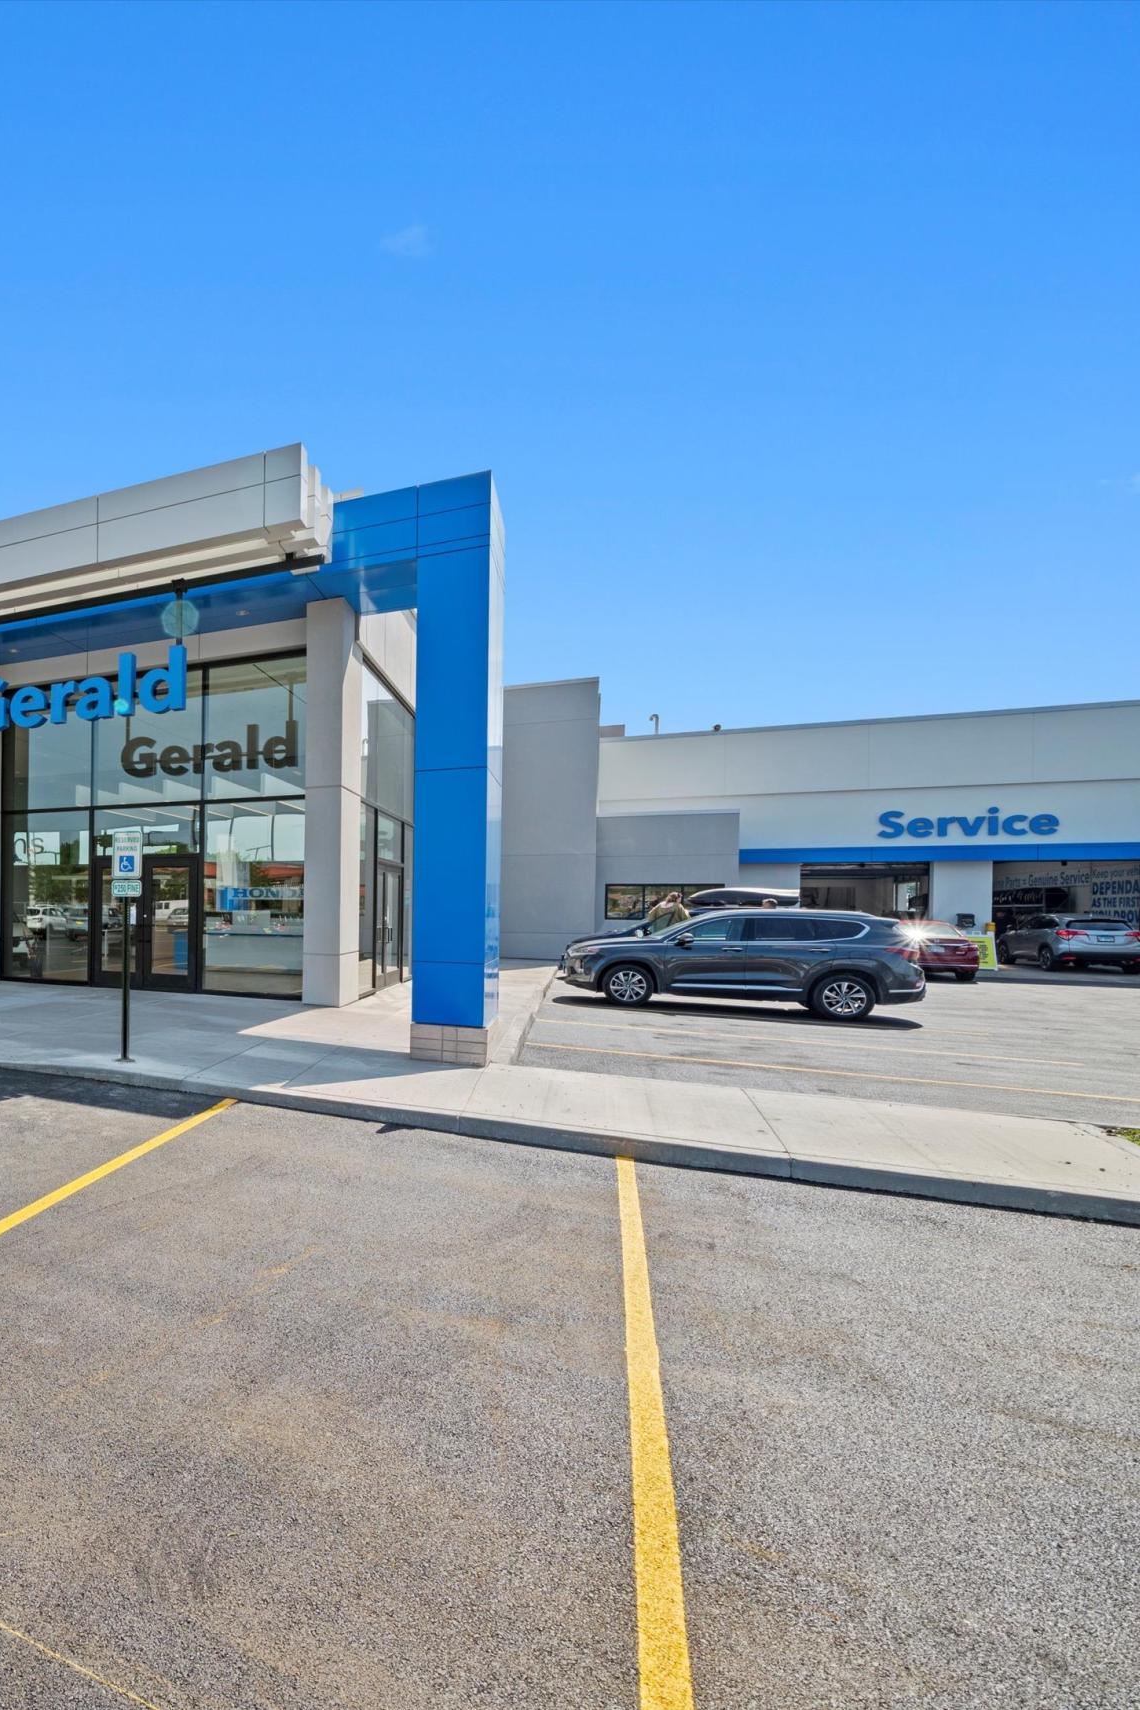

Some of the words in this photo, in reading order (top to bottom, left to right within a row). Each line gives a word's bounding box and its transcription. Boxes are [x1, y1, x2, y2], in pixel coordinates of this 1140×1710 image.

[121, 720, 300, 778] Gerald
[877, 806, 1060, 839] Service
[1028, 874, 1058, 887] Genuine
[1060, 870, 1090, 884] Service
[127, 884, 140, 893] FINE
[1092, 880, 1140, 895] DEPENDA
[1092, 897, 1101, 907] AS
[1103, 896, 1117, 907] THE
